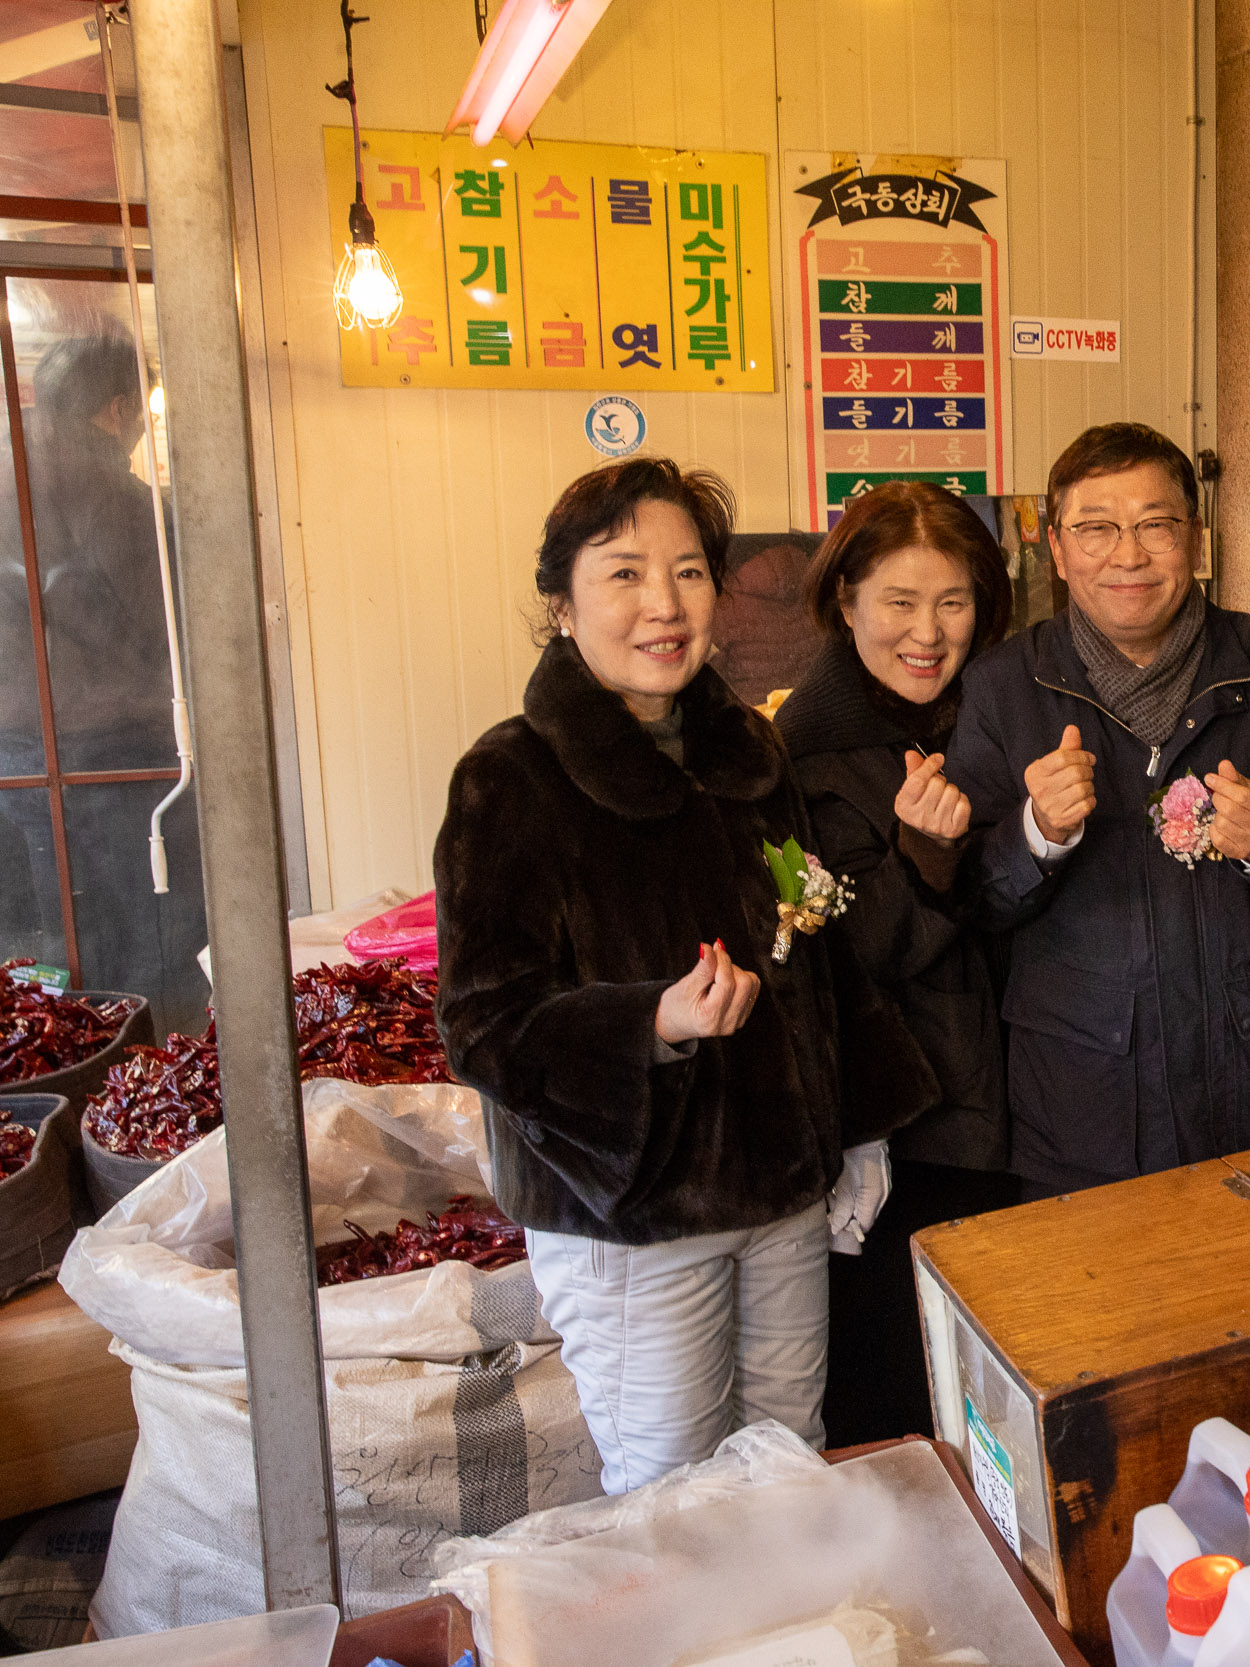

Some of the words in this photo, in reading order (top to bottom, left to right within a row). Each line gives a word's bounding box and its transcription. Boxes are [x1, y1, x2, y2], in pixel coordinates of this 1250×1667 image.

[840, 181, 950, 222] 극동상회
[454, 170, 512, 367] 참기름
[679, 182, 732, 370] 미수가루
[1046, 329, 1117, 353] CCTV녹화중
[844, 361, 962, 391] 참기름
[839, 399, 964, 429] 들기름
